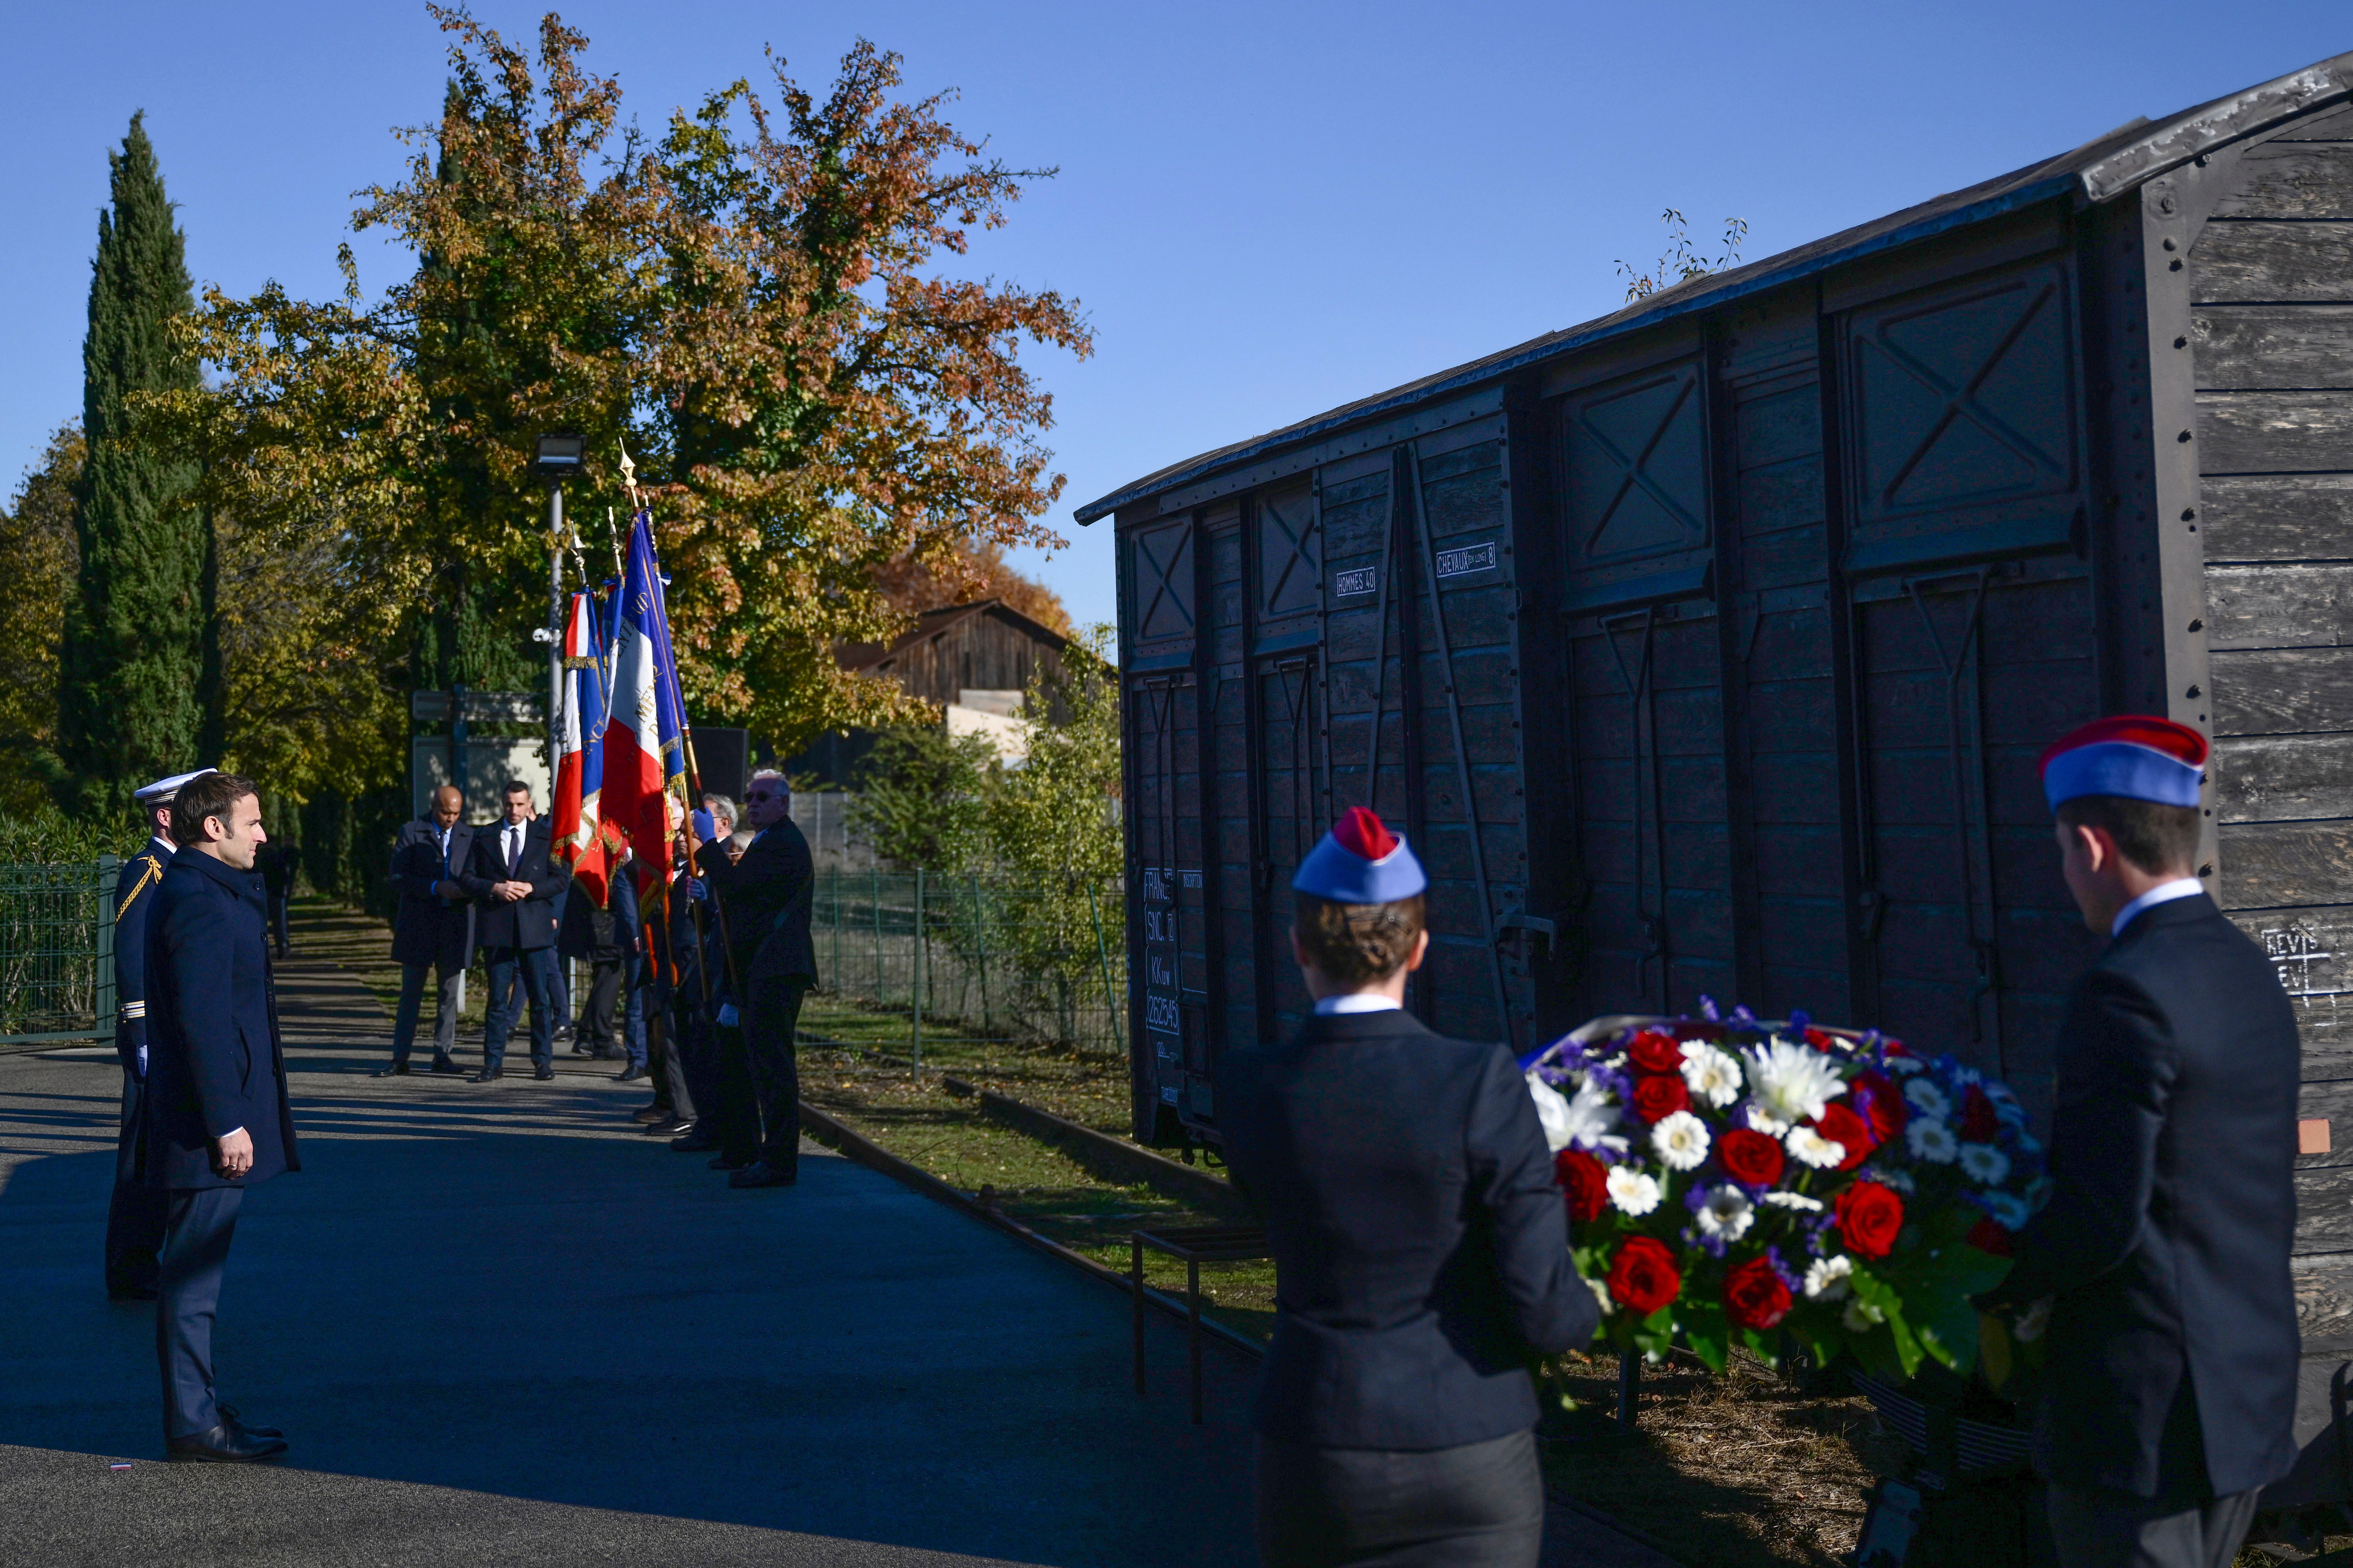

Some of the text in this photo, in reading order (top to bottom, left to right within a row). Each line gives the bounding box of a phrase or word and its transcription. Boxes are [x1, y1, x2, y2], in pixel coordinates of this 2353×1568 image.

[1438, 551, 1469, 574] CHEVAUX
[1488, 546, 1493, 564] 8
[1338, 571, 1374, 593] HOMMES 40
[1148, 911, 1165, 941] SNC
[1149, 995, 1178, 1028] 262545
